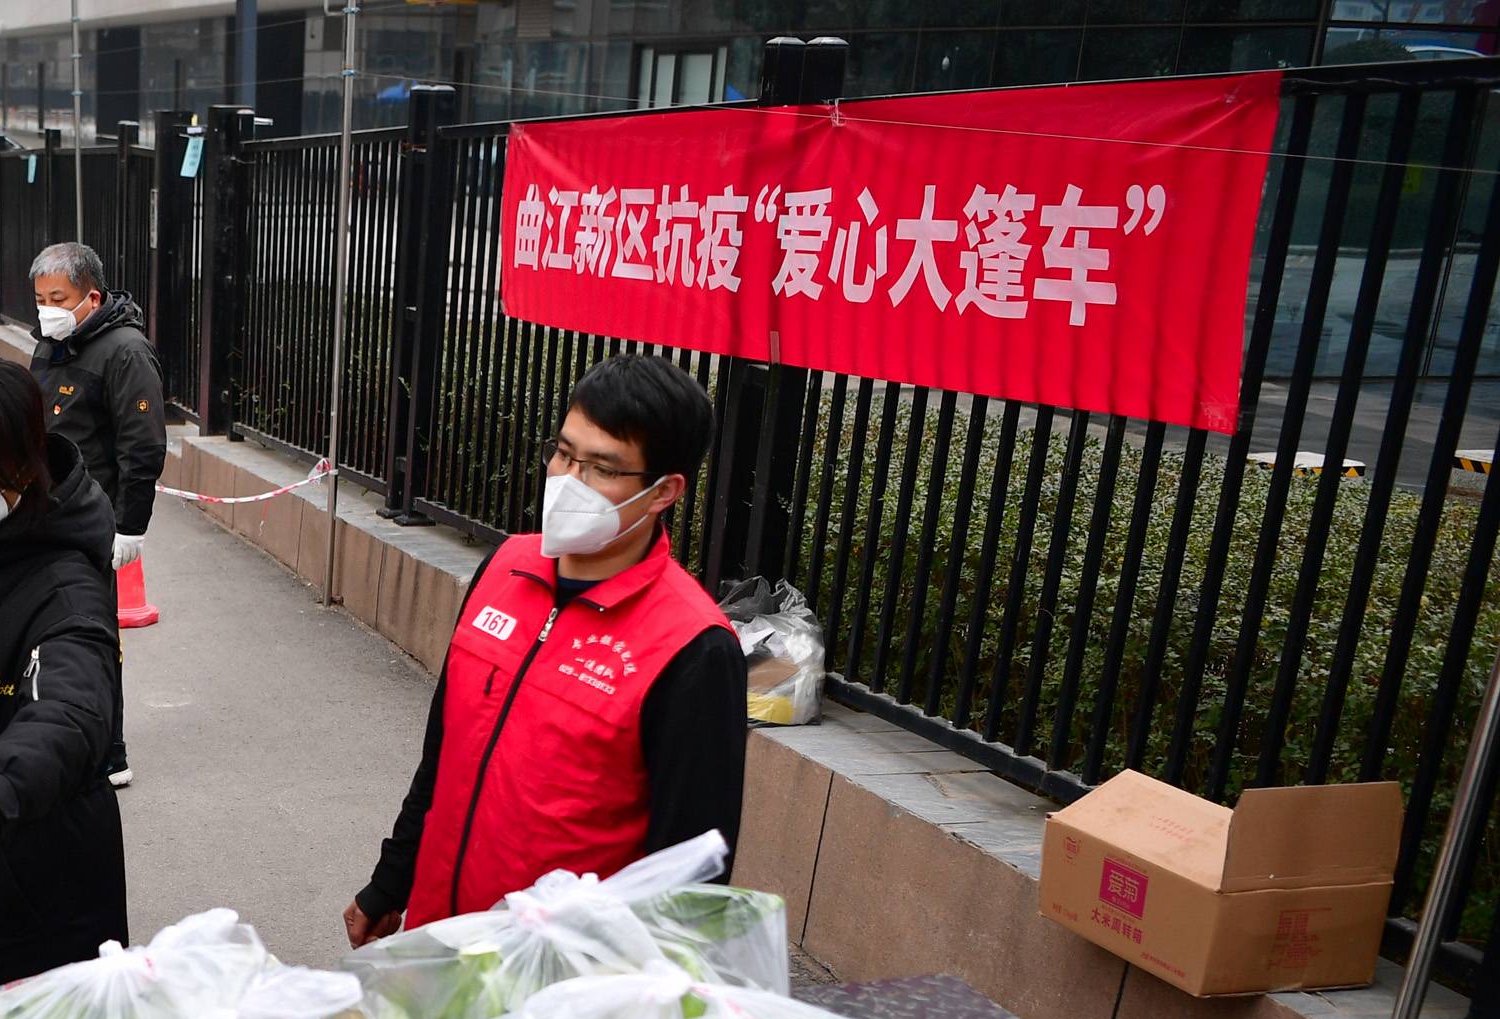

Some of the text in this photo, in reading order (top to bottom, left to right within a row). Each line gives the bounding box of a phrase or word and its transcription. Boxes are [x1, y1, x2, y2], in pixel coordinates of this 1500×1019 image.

[512, 183, 1166, 326] 曲江新区抗疫“爱心大篷车”
[481, 611, 509, 635] 161
[1107, 870, 1140, 903] 爱菊
